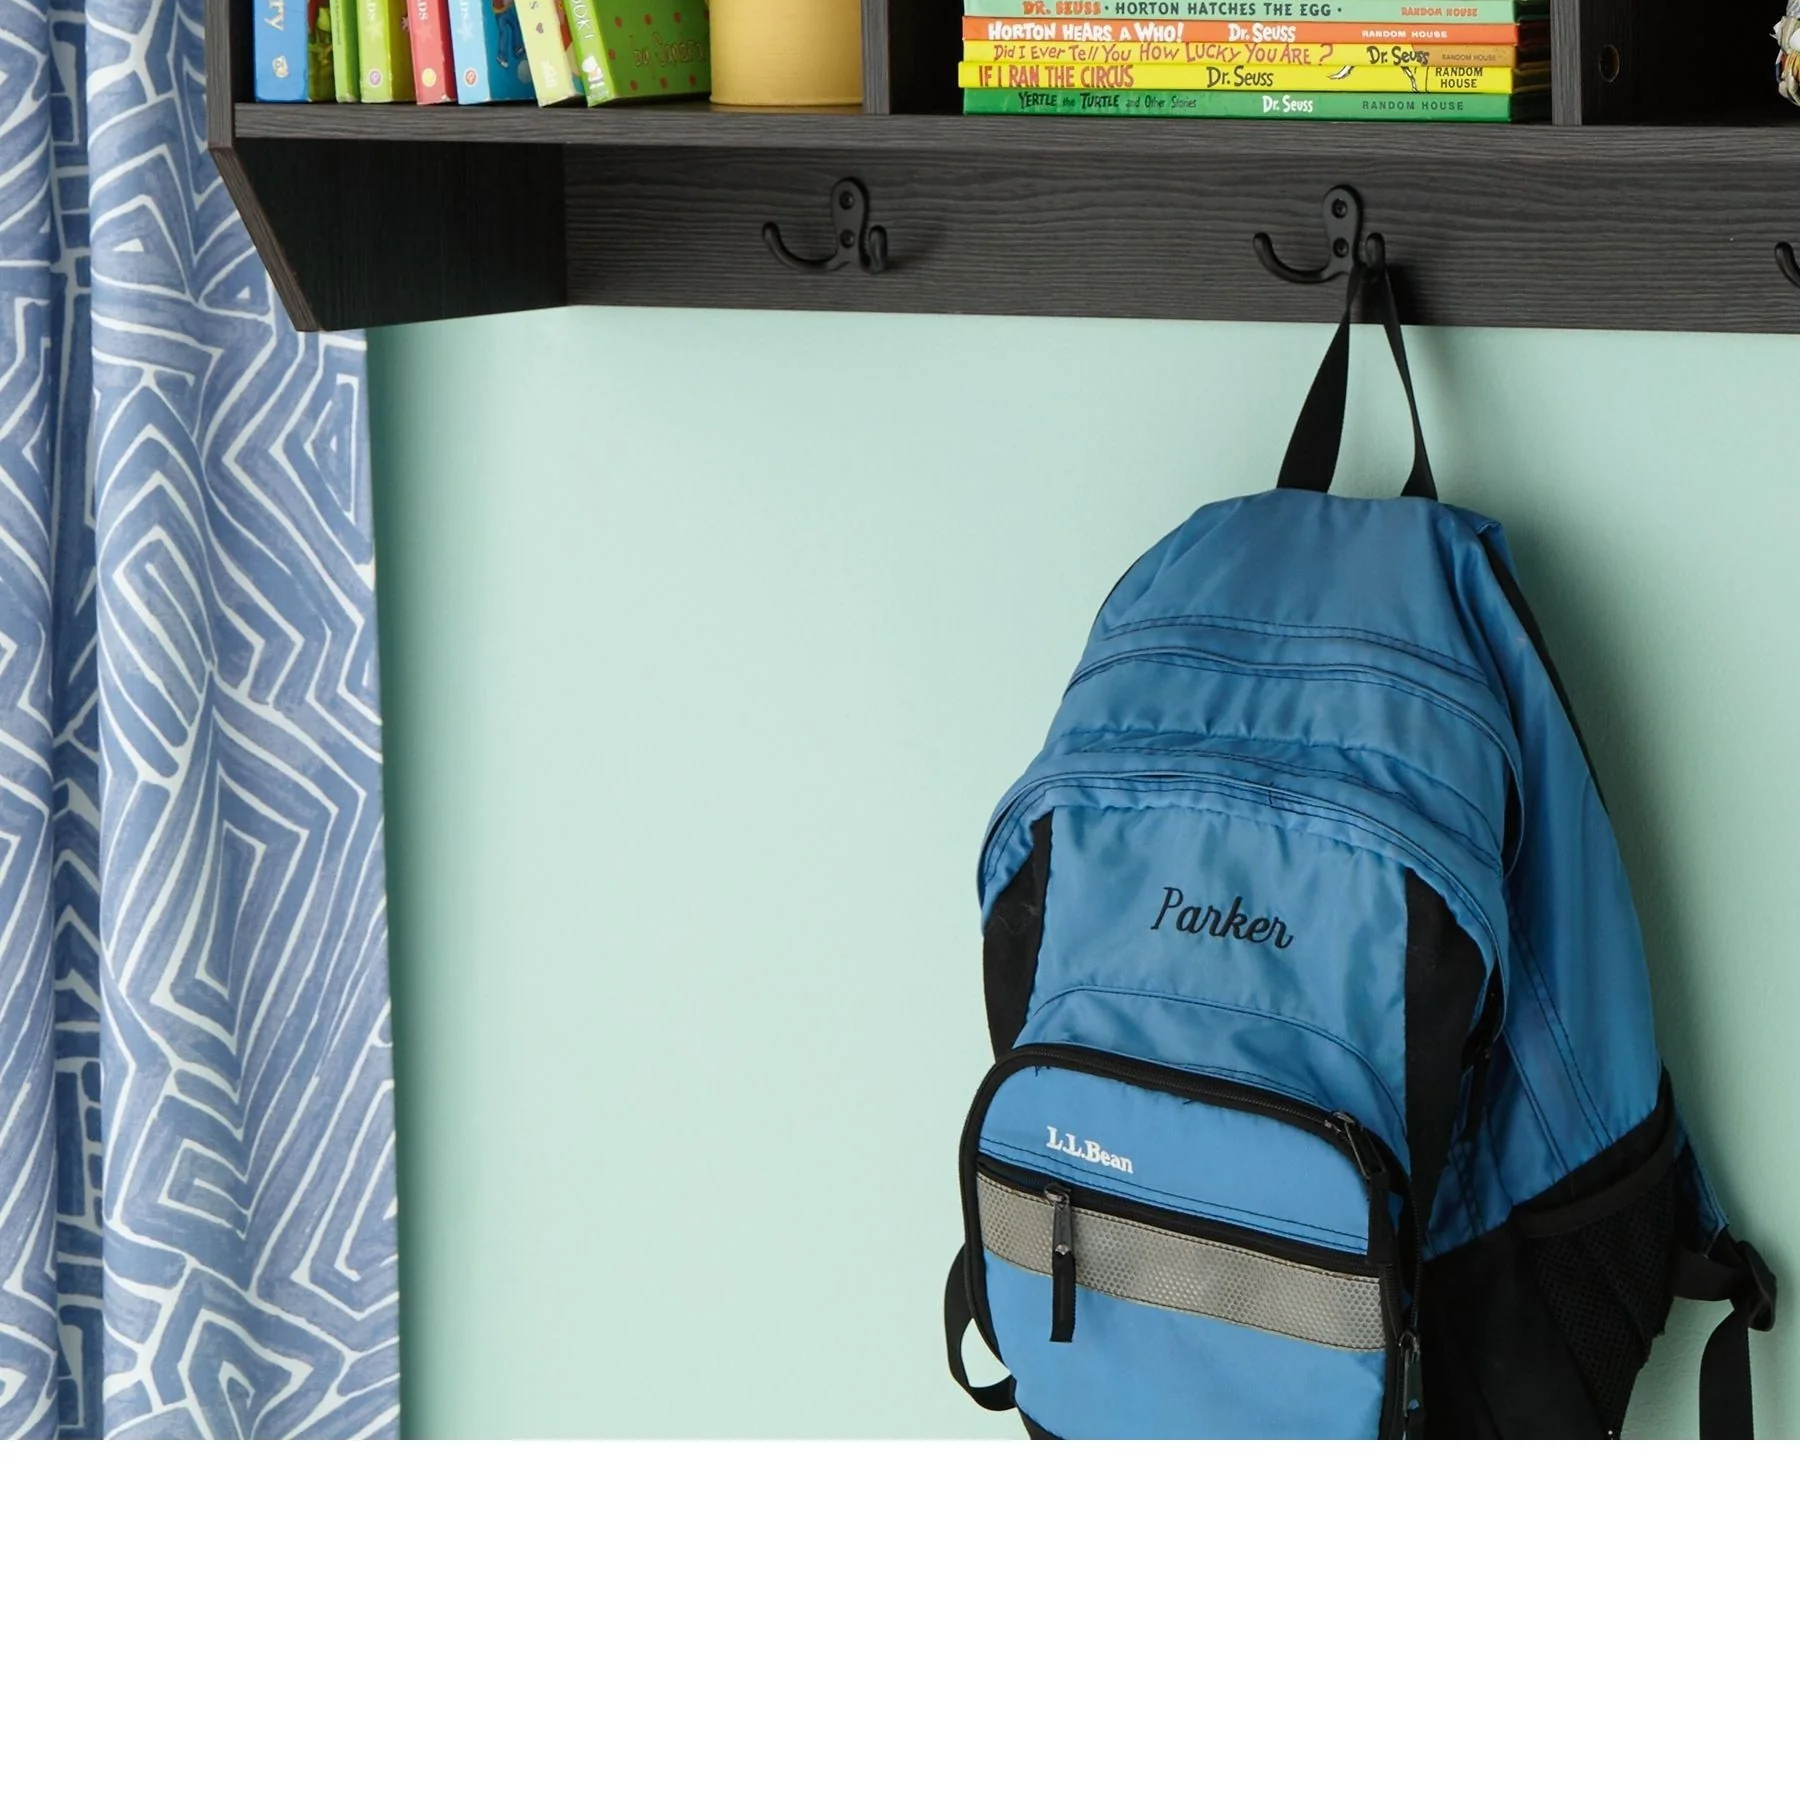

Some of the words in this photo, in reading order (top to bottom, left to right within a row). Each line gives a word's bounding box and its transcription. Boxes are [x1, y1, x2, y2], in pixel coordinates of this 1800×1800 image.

[1022, 1, 1050, 15] DR.
[1055, 1, 1101, 15] SEUSS
[1115, 1, 1180, 15] HORTON
[1187, 1, 1256, 16] HATCHES
[1265, 2, 1293, 16] THE
[1299, 3, 1331, 17] EGG
[1401, 7, 1442, 16] RANDOM
[1446, 8, 1478, 17] HOUSE
[988, 22, 1056, 42] HORTON
[1062, 22, 1113, 42] HEARS
[1119, 26, 1132, 41] A
[1133, 21, 1184, 43] WHO!
[1227, 21, 1250, 42] Dr.
[1252, 22, 1297, 43] Seuss
[1361, 30, 1406, 38] RANDOM
[1411, 30, 1448, 39] HOUSE
[993, 44, 1016, 62] Did
[1018, 45, 1025, 60] I
[1030, 45, 1066, 60] Ever
[1070, 44, 1099, 62] Tell
[1101, 43, 1132, 62] You
[1138, 42, 1181, 62] HOW
[1184, 41, 1242, 63] LUCKY
[1243, 42, 1278, 65] YOU
[1281, 43, 1312, 65] ARE
[1367, 45, 1389, 65] Dr.
[1391, 45, 1430, 66] Seuss
[1441, 53, 1472, 61] RANDOM
[1473, 54, 1497, 62] HOUSE
[978, 65, 993, 88] IF
[998, 65, 1003, 88] I
[1008, 64, 1040, 88] RAN
[1044, 64, 1076, 88] THE
[1080, 64, 1135, 89] CIRCUS
[1206, 66, 1231, 88] Dr.
[1233, 66, 1274, 87] Seuss
[1435, 67, 1483, 77] RANDOM
[1440, 78, 1478, 89] HOUSE
[1018, 91, 1058, 109] YERTLE
[1063, 96, 1076, 108] the
[1079, 92, 1120, 109] TURTLE
[1125, 97, 1140, 108] and
[1144, 95, 1166, 108] Other
[1170, 96, 1197, 108] Stories
[1262, 95, 1280, 113] Dr.
[1282, 95, 1314, 113] Seuss
[1362, 101, 1415, 111] RANDOM
[1422, 101, 1465, 111] HOUSE
[1150, 886, 1295, 950] Parker
[1045, 1125, 1135, 1176] L.L.Bean
